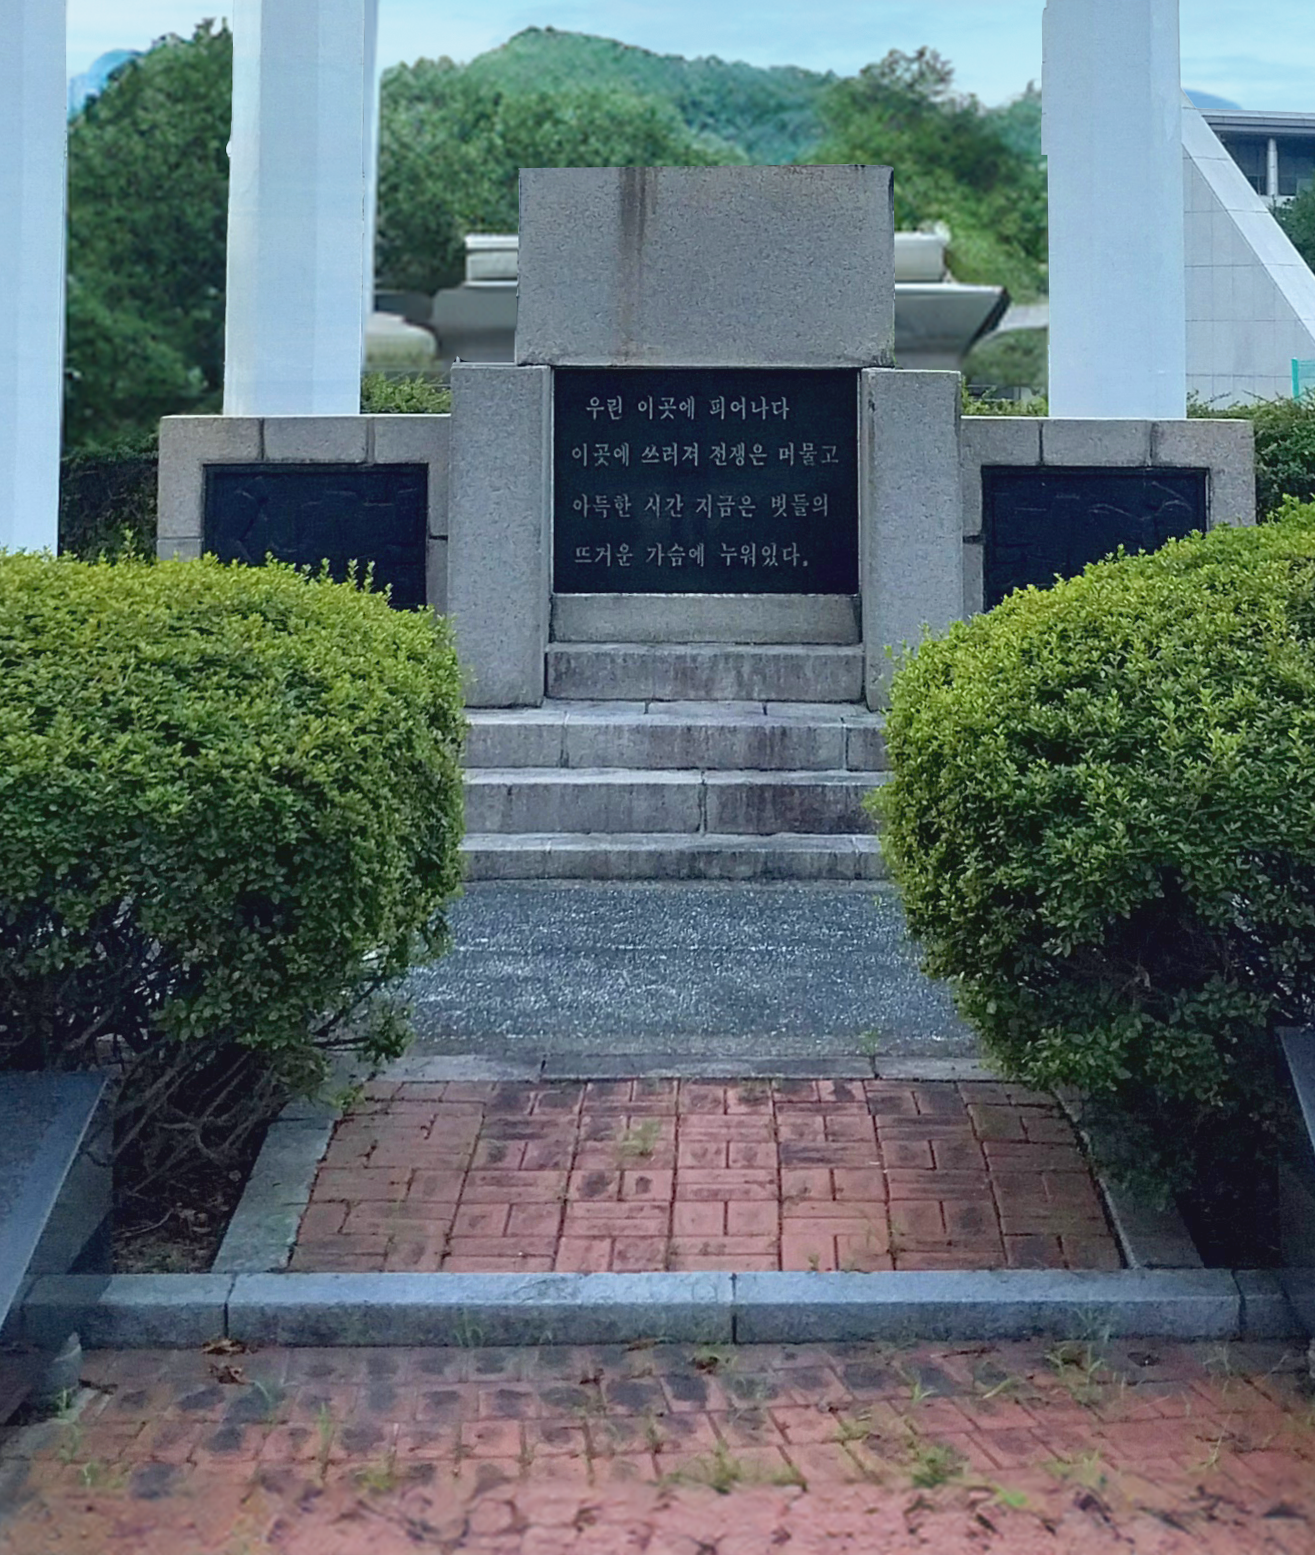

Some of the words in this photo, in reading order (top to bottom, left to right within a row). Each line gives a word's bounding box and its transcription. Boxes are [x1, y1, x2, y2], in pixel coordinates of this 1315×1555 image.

[586, 396, 623, 420] 우린
[637, 395, 695, 420] 이곳에
[709, 396, 790, 420] 피어나다
[571, 442, 630, 467] 이곳에
[641, 443, 699, 467] 쓰러져
[709, 443, 767, 467] 전쟁은
[778, 443, 839, 466] 머물고
[572, 494, 632, 518] 아득한
[644, 494, 685, 518] 시간
[695, 494, 756, 518] 지금은
[574, 542, 633, 566] 뜨거운
[646, 542, 705, 567] 가슴에
[720, 542, 808, 567] 누워있다.
